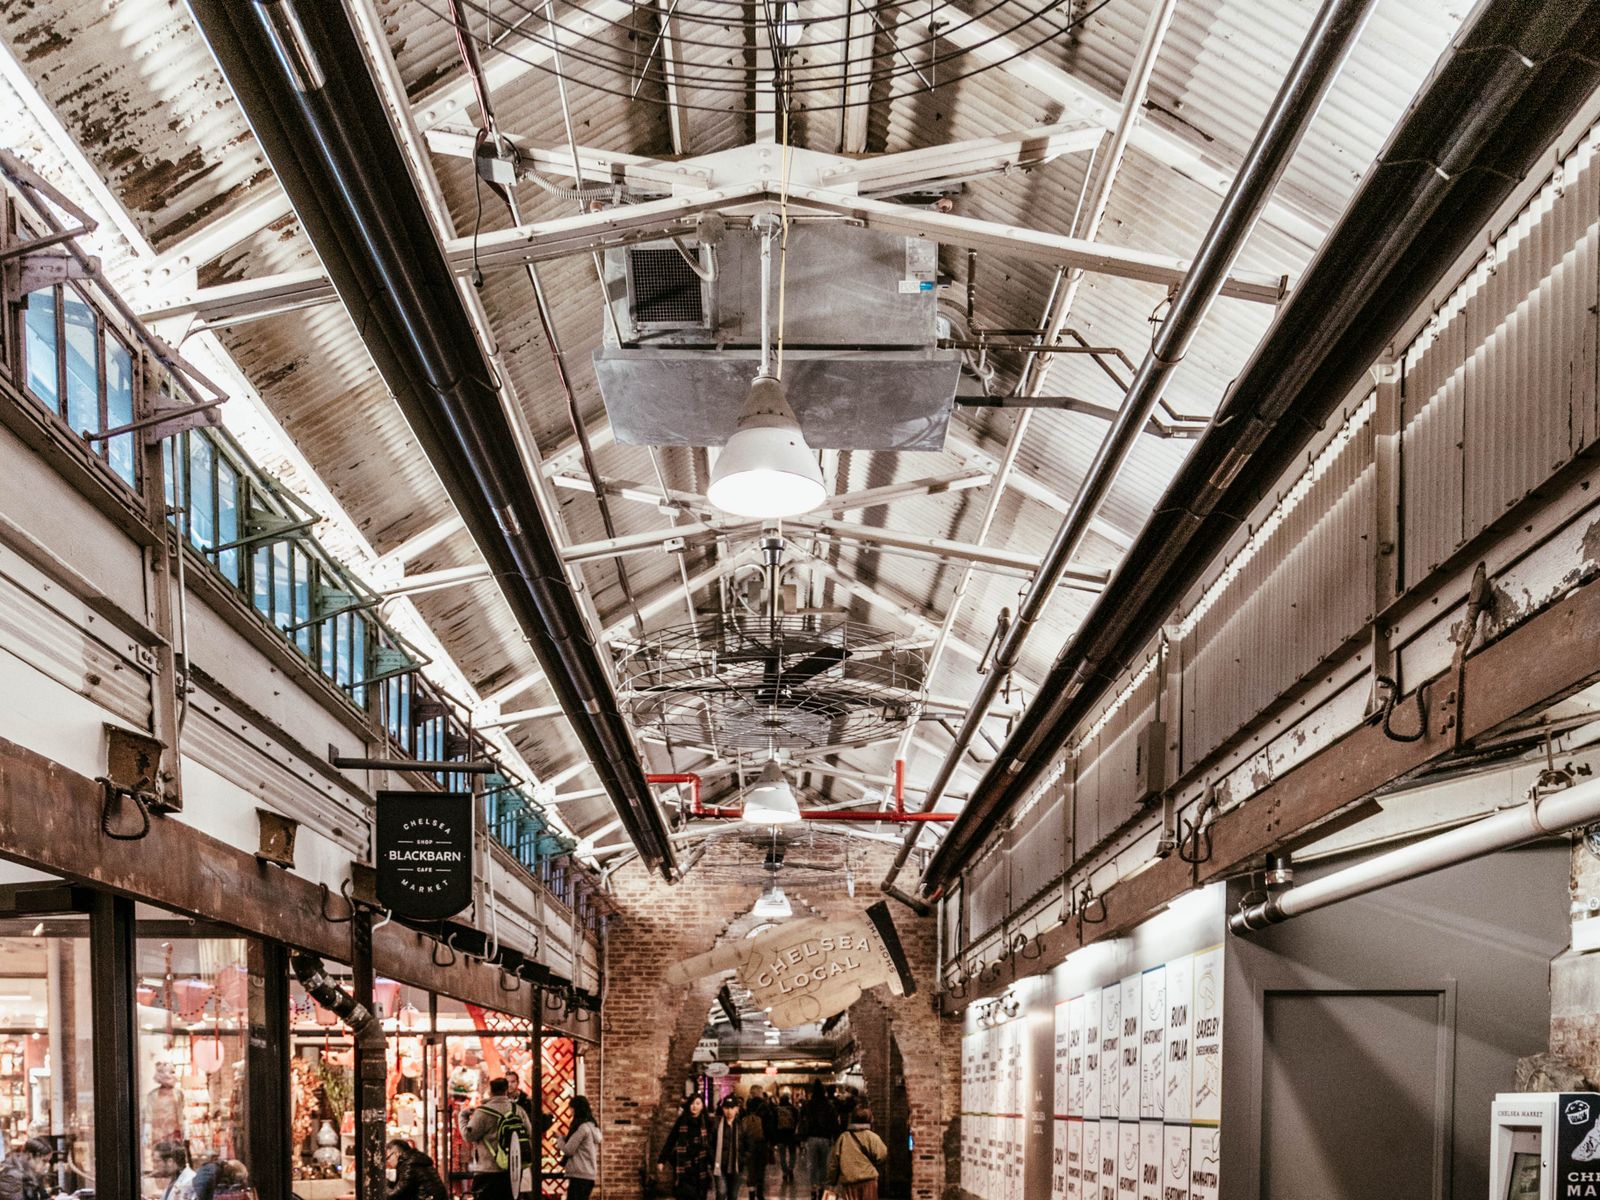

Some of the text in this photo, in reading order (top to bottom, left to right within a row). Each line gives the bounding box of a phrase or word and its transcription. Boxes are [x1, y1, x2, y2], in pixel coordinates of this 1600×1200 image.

[402, 818, 451, 835] CHELSEA
[389, 850, 461, 861] BLACKBARN
[401, 878, 448, 893] MARKET
[758, 935, 871, 988] CHELSEA
[878, 944, 897, 974] SHOP
[780, 956, 861, 994] LOCAL
[1171, 1003, 1188, 1028] BUON
[1169, 1039, 1188, 1062] ITALIA
